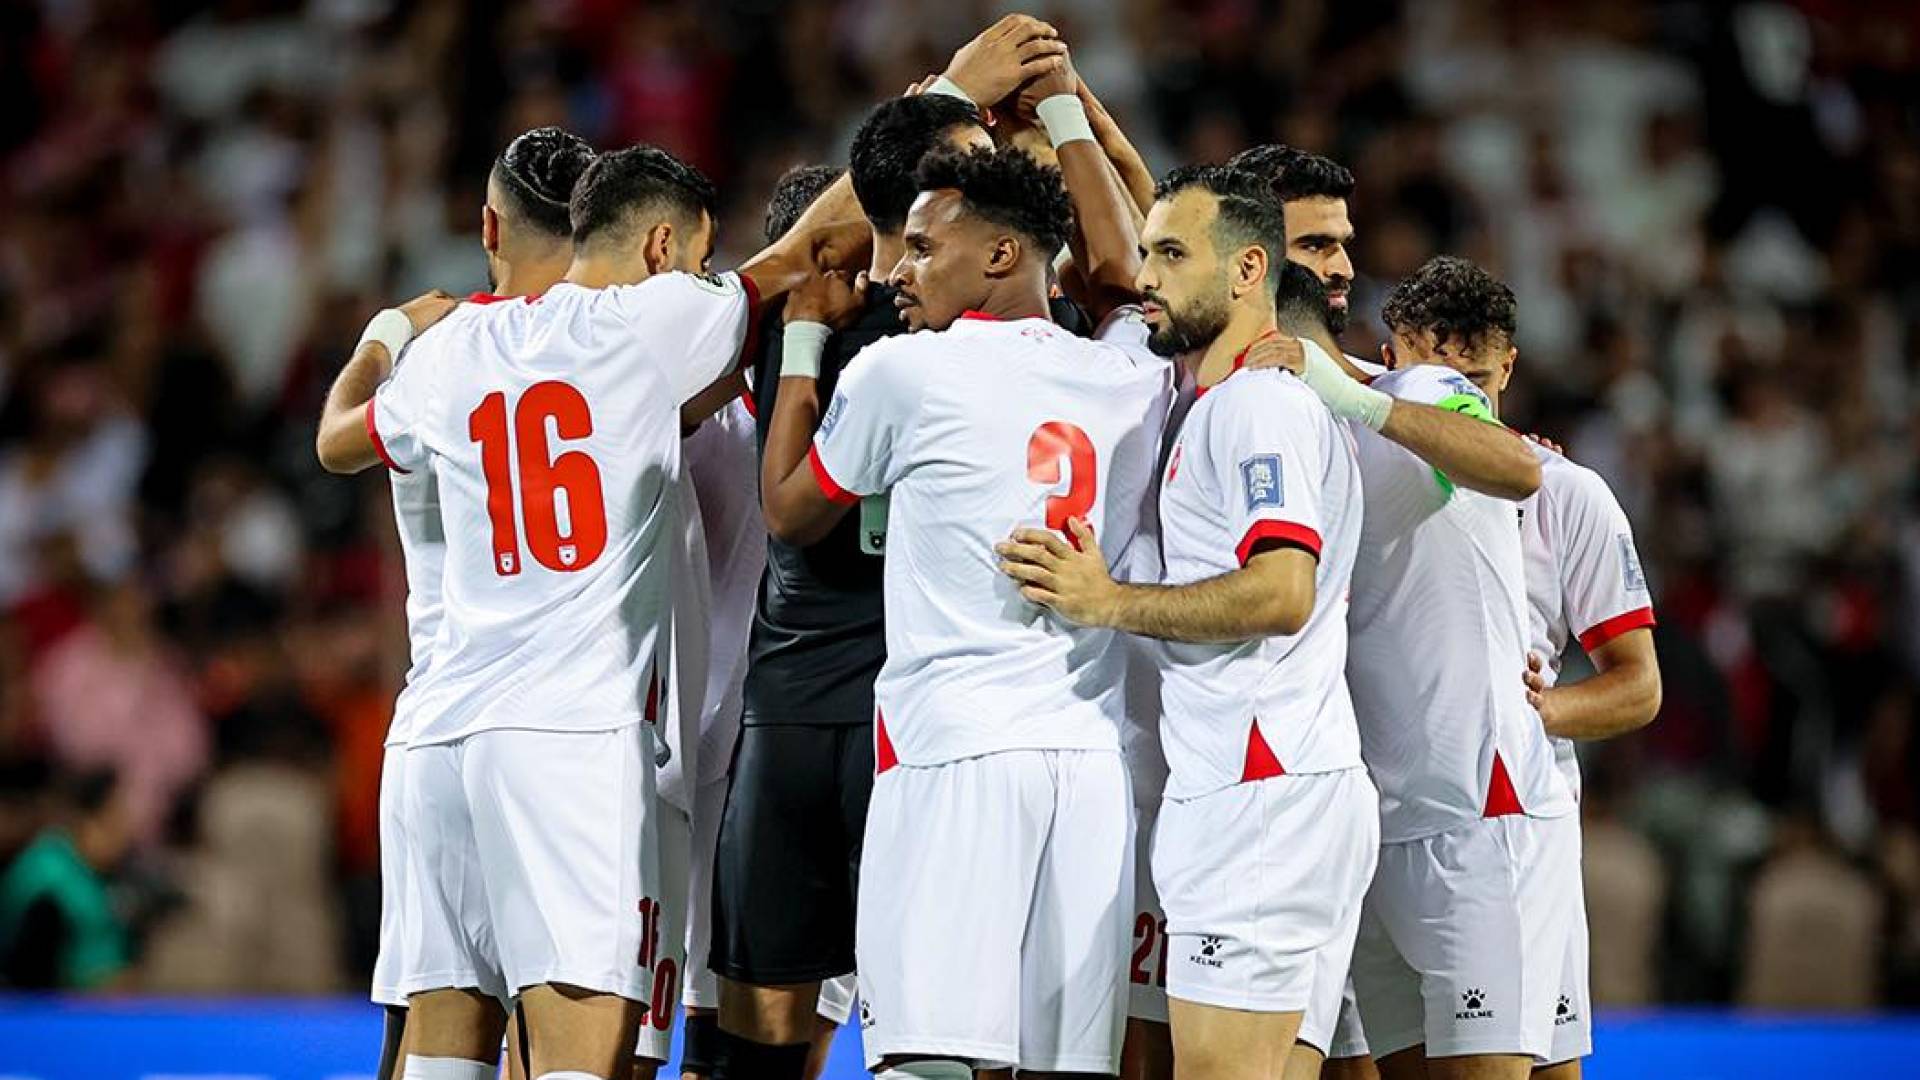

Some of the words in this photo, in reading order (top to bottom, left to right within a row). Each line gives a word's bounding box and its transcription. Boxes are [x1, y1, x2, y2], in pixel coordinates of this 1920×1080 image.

[469, 380, 607, 575] 16
[1027, 421, 1096, 552] 3
[1131, 912, 1168, 987] 21
[1190, 955, 1223, 968] KELME
[641, 957, 676, 1031] 0
[1456, 1010, 1494, 1018] KELME
[1554, 1014, 1577, 1025] ELME
